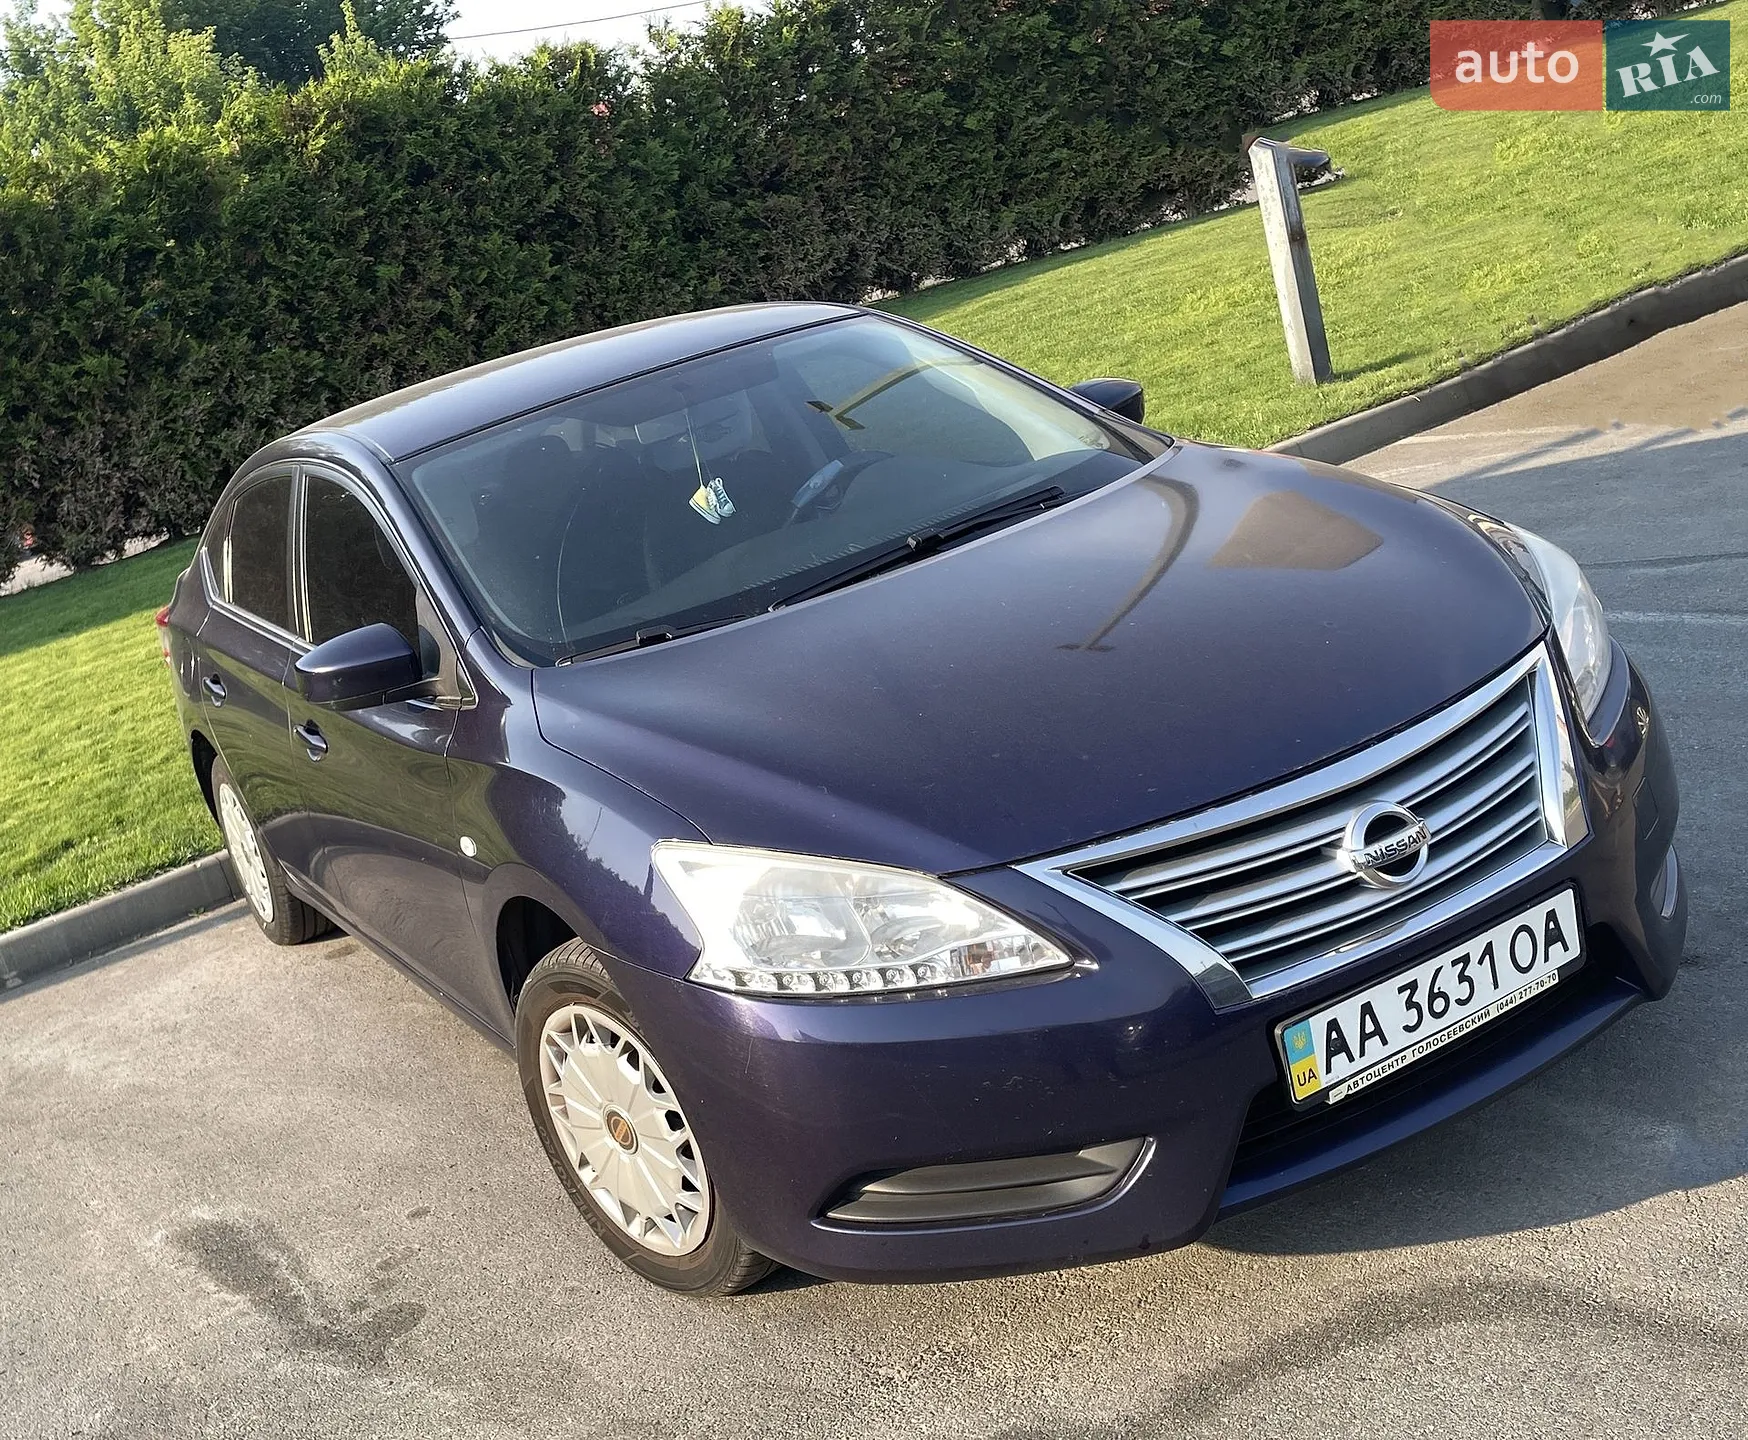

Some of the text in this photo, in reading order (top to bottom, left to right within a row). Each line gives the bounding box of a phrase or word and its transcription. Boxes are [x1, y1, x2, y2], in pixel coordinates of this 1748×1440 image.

[1364, 825, 1427, 865] NISSAN
[1325, 908, 1569, 1075] AA 3631 OA
[1346, 973, 1557, 1094] АВТОЦЕНТР ГОЛОСЕЕВСКИЙ (044) 277-70-70
[1297, 1068, 1318, 1087] UA
